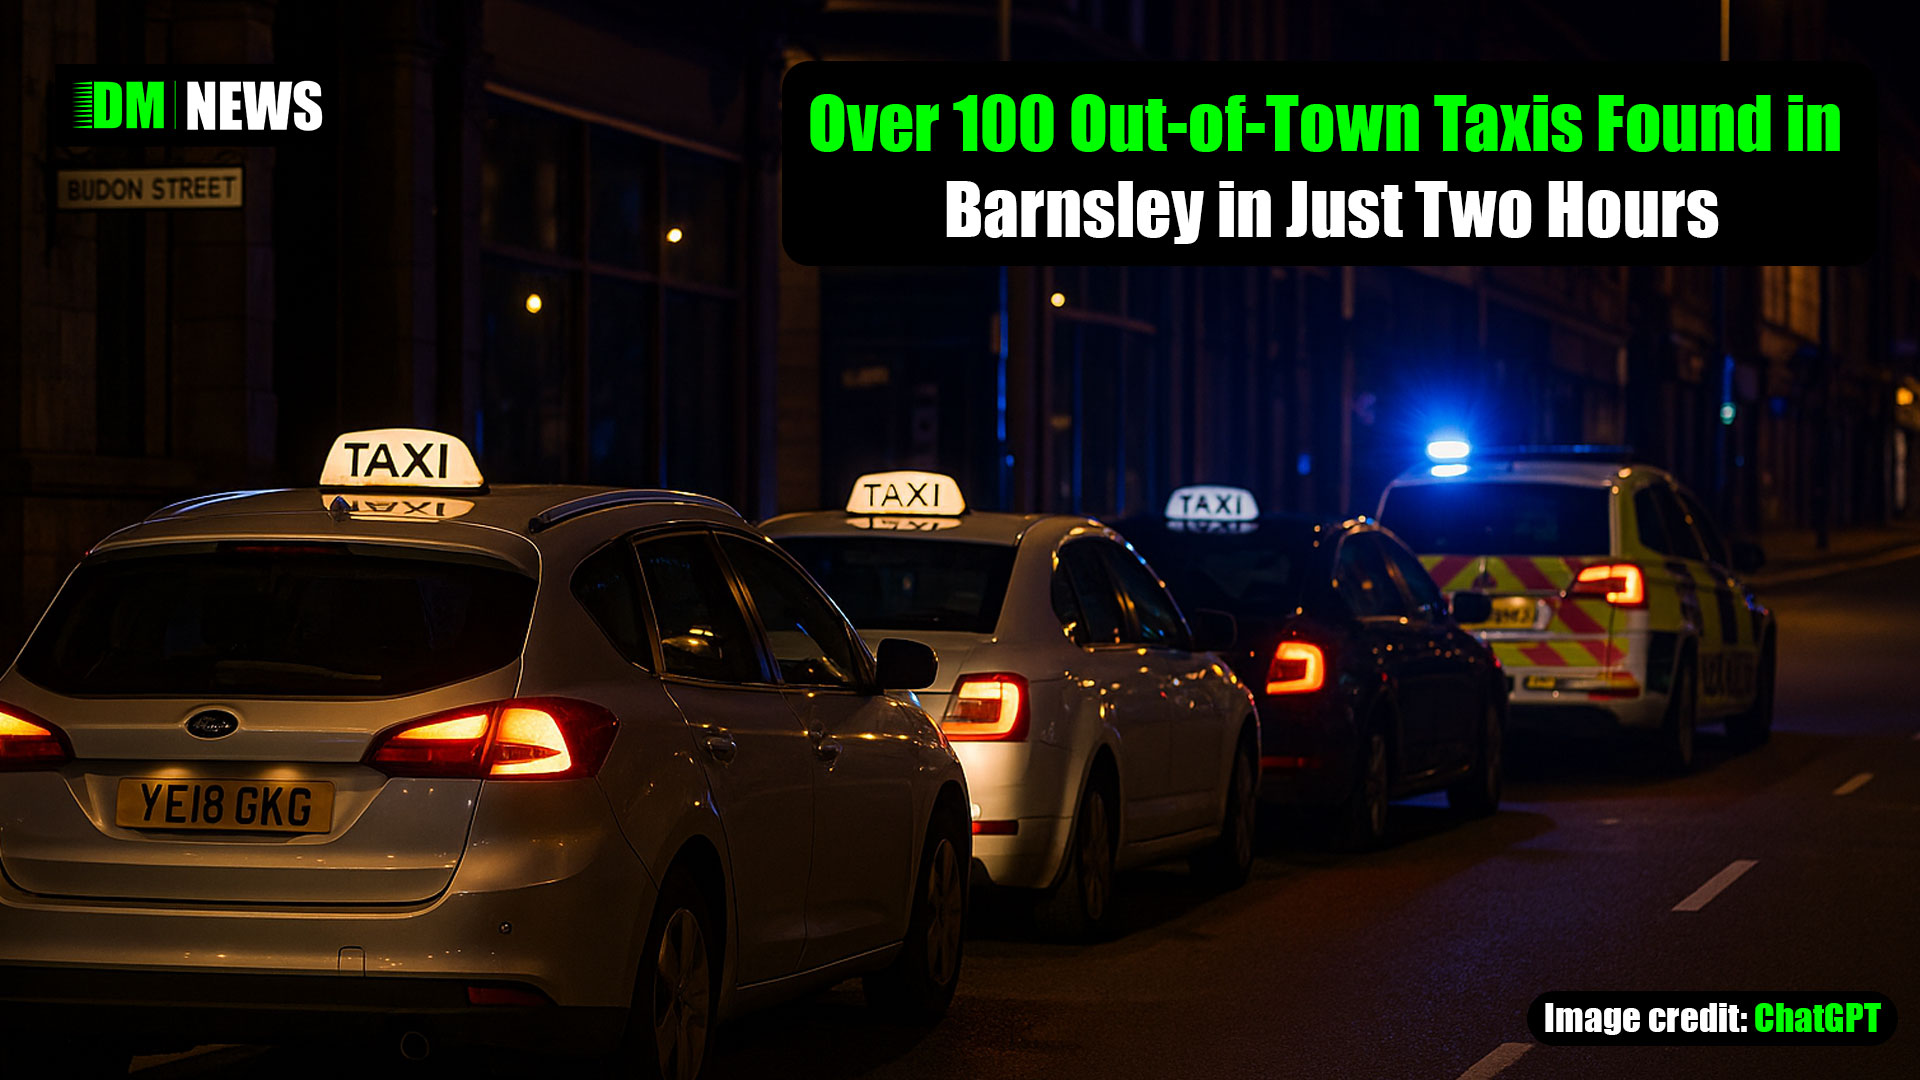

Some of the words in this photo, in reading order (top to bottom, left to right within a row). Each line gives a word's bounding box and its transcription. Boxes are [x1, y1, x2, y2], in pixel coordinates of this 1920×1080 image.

[67, 178, 143, 201] BUDON
[152, 176, 236, 199] STREET
[344, 442, 448, 479] TAXI
[864, 482, 939, 507] TAXI
[1180, 494, 1242, 514] TAXI
[141, 783, 225, 824] YE18
[235, 786, 312, 826] GKG
